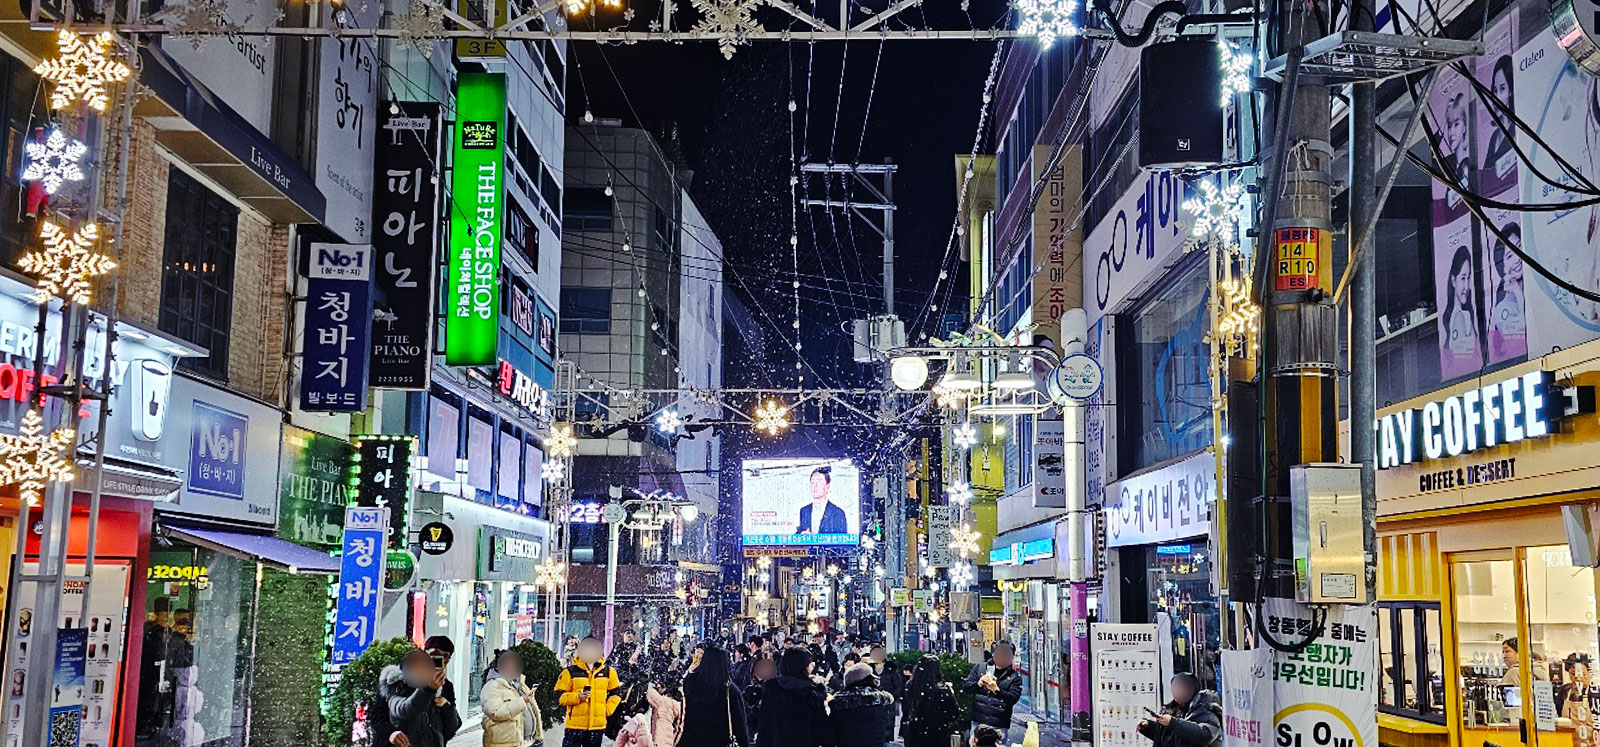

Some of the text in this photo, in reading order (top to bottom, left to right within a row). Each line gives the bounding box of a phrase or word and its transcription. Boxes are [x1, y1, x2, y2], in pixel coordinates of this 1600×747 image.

[237, 35, 266, 75] artist
[469, 41, 497, 54] 3F
[1519, 48, 1545, 72] Clalen
[411, 120, 426, 129] Bar
[250, 146, 291, 189] Live Bar
[476, 161, 496, 204] THE
[383, 167, 426, 289] 피아노
[1282, 244, 1302, 257] 14
[1290, 277, 1305, 286] ES
[315, 291, 356, 388] 청바지
[374, 345, 421, 356] PIANO
[384, 335, 410, 344] THE
[1423, 370, 1546, 460] COFFEE
[311, 455, 341, 476] Live Bar
[1419, 457, 1516, 492] COFFEE & DESSERT
[288, 472, 318, 502] THE
[338, 536, 377, 648] 청바지
[1097, 632, 1153, 642] STAY COFFEE
